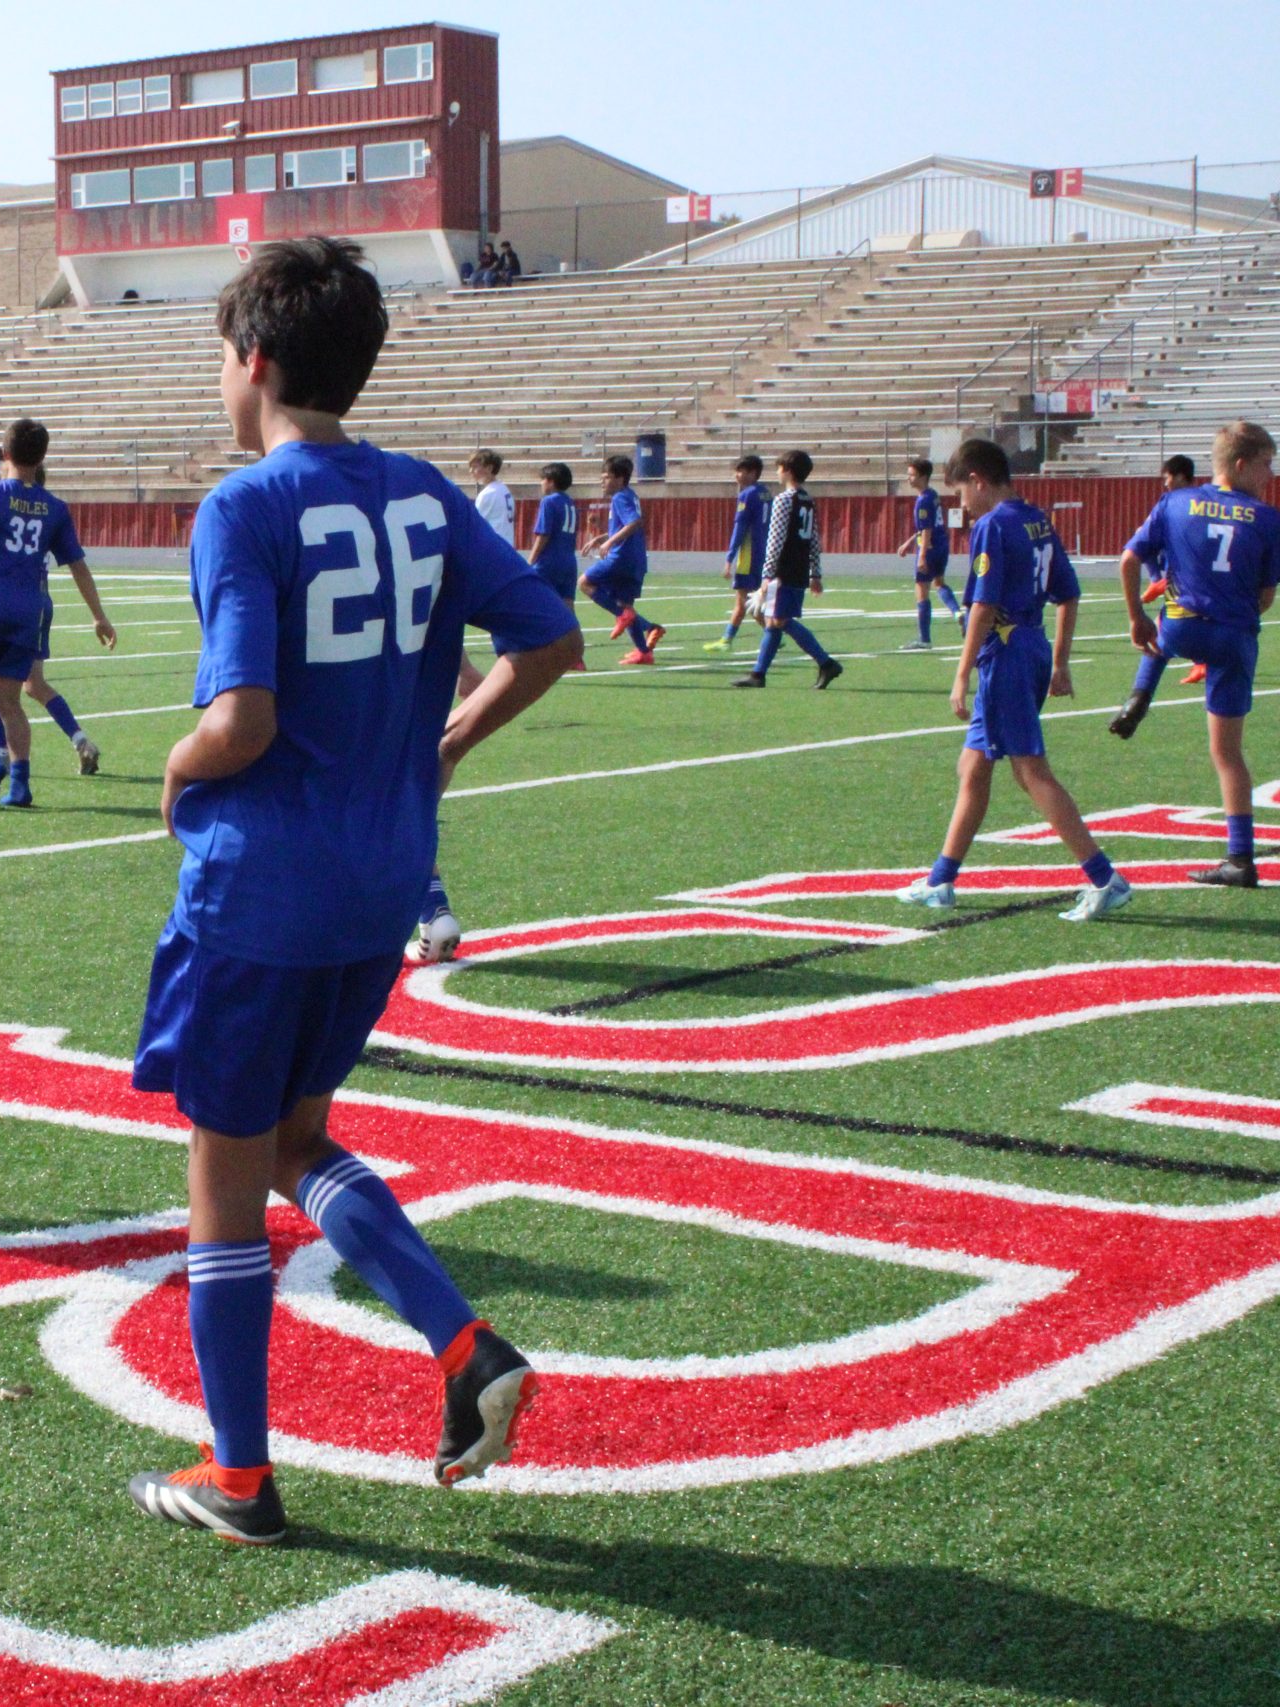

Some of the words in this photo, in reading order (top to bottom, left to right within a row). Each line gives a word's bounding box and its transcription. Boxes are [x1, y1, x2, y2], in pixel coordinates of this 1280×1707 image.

[1061, 170, 1077, 196] F
[694, 196, 708, 221] E
[235, 246, 251, 264] D
[10, 496, 48, 516] MULES
[562, 504, 577, 534] 11
[1188, 499, 1255, 523] MULES
[5, 516, 43, 555] 33
[1207, 523, 1234, 572] 7
[298, 493, 447, 663] 26
